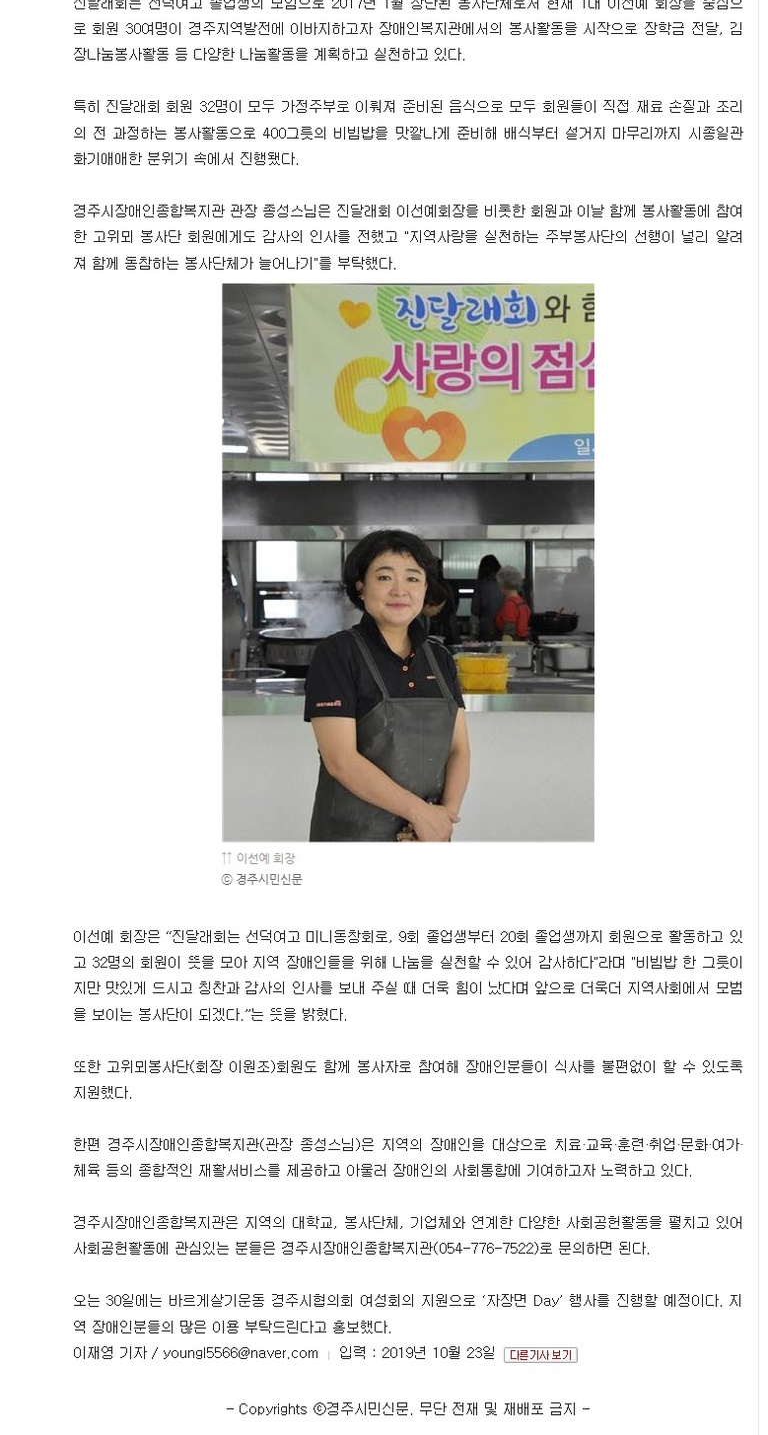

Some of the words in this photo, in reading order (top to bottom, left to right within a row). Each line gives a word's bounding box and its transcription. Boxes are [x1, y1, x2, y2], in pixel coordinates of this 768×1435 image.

[74, 48, 169, 61] 장나눔봉사활동
[175, 48, 187, 61] 등
[194, 48, 235, 61] 다양한
[240, 48, 308, 61] 나눔활동을
[314, 48, 368, 61] 계획하고
[374, 48, 428, 61] 실천하고
[435, 48, 465, 61] 있다.
[74, 152, 142, 165] 화기애애한
[148, 152, 187, 165] 분위기
[194, 152, 233, 165] 속에서
[240, 152, 298, 165] 진행됐다.
[383, 342, 520, 392] 사랑의
[237, 853, 269, 864] 이선예
[274, 853, 295, 864] 회장
[237, 874, 302, 885] 경주시민신문
[74, 1008, 86, 1021] 을
[93, 1008, 132, 1021] 보이는
[139, 1008, 192, 1021] 봉사단이
[270, 1008, 296, 1021] 뜻을
[302, 1008, 346, 1021] 밝혔다.
[74, 1086, 131, 1099] 지원했다.
[74, 1241, 168, 1255] 사회공헌활동에
[175, 1241, 229, 1255] 관심있는
[236, 1241, 275, 1255] 분들은
[282, 1241, 552, 1255] 경주시장애인종합복지관(054-776-7522)로
[559, 1242, 612, 1255] 문의하면
[619, 1242, 649, 1255] 된다.
[74, 1320, 85, 1334] 역
[93, 1320, 173, 1334] 장애인분들의
[180, 1320, 206, 1334] 많은
[213, 1320, 239, 1334] 이용
[245, 1320, 326, 1334] 부탁드린다고
[333, 1320, 391, 1334] 홍보했다.
[74, 1346, 113, 1359] 이재영
[120, 1346, 147, 1359] 기자
[340, 1346, 365, 1359] 입력
[382, 1346, 425, 1359] 2019년
[434, 1346, 460, 1359] 10월
[467, 1346, 494, 1359] 23일
[510, 1350, 549, 1360] 다른기사
[552, 1350, 571, 1360] 보기
[239, 1403, 307, 1416] Copyrights
[420, 1402, 447, 1416] 무단
[452, 1402, 477, 1416] 전재
[485, 1402, 497, 1416] 및
[504, 1402, 543, 1415] 재배포
[550, 1402, 575, 1416] 금지
